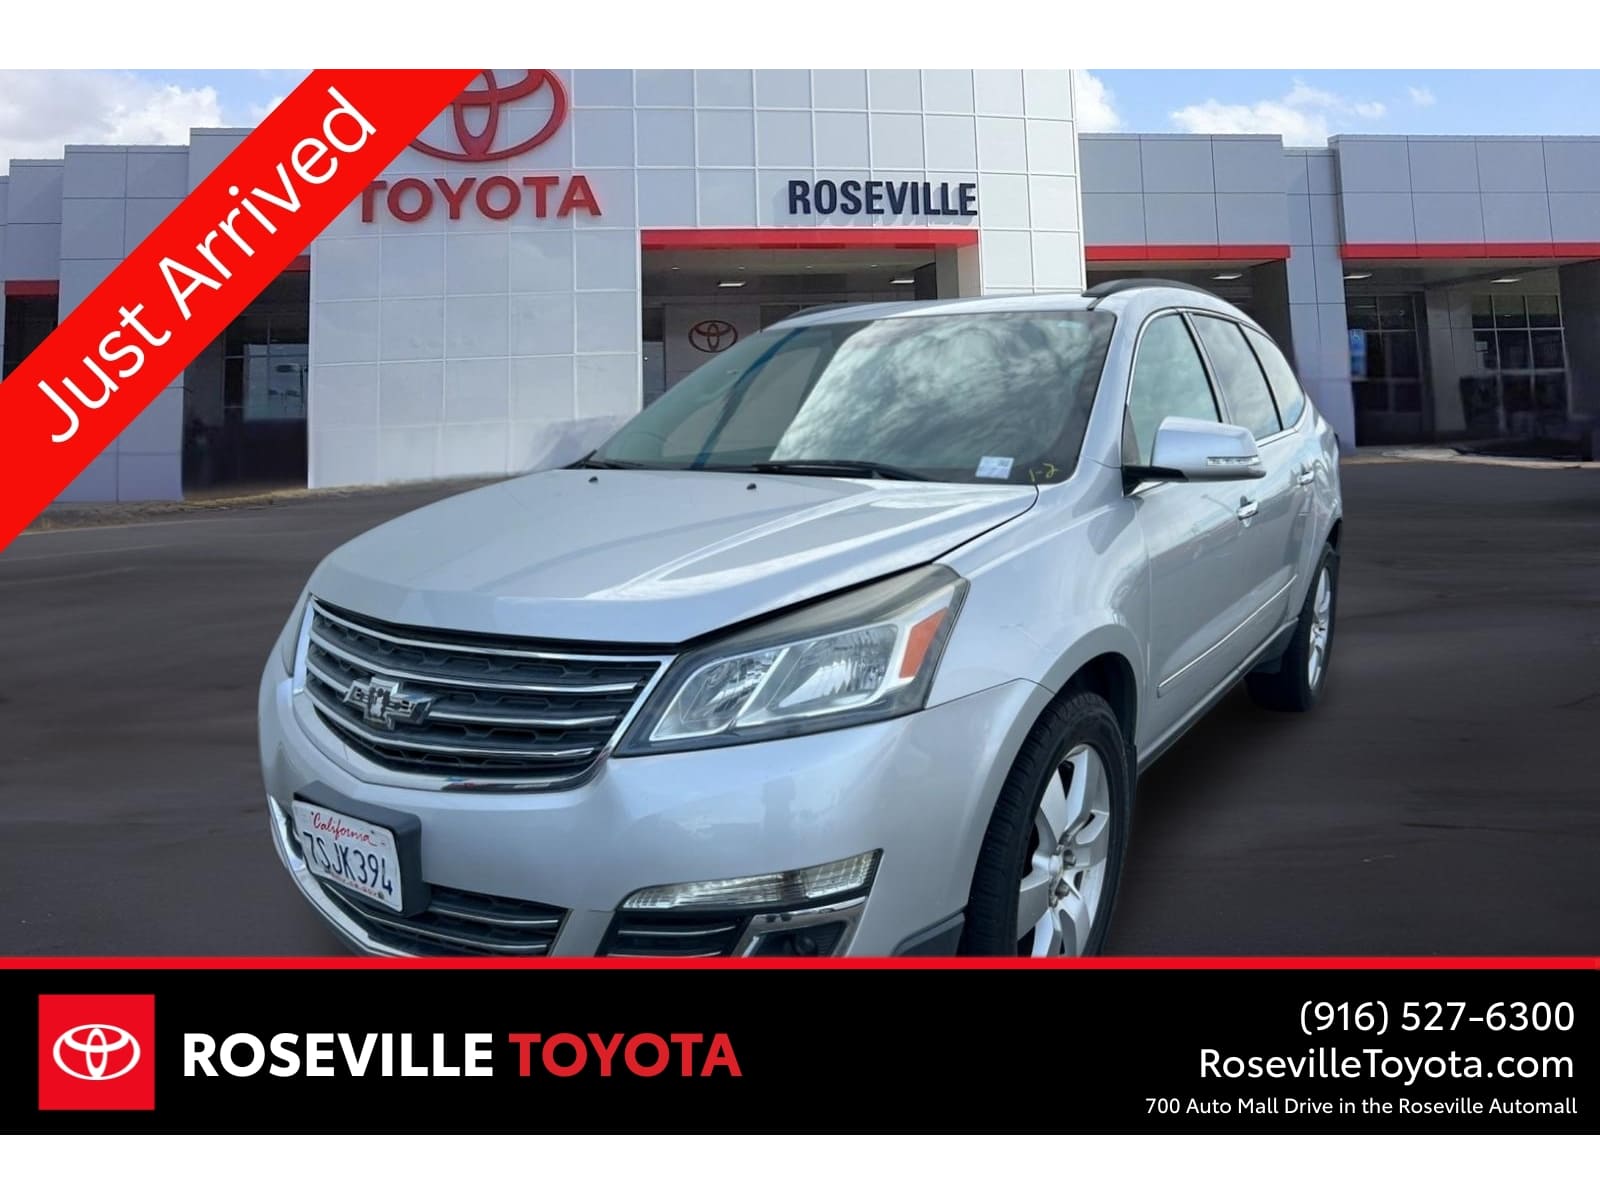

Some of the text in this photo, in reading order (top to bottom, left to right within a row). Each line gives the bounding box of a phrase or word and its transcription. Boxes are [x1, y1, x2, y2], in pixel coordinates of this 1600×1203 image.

[361, 174, 602, 223] TOYOTA
[787, 179, 979, 217] ROSEVILLE
[312, 811, 378, 848] California
[303, 831, 394, 896] 7SJK394
